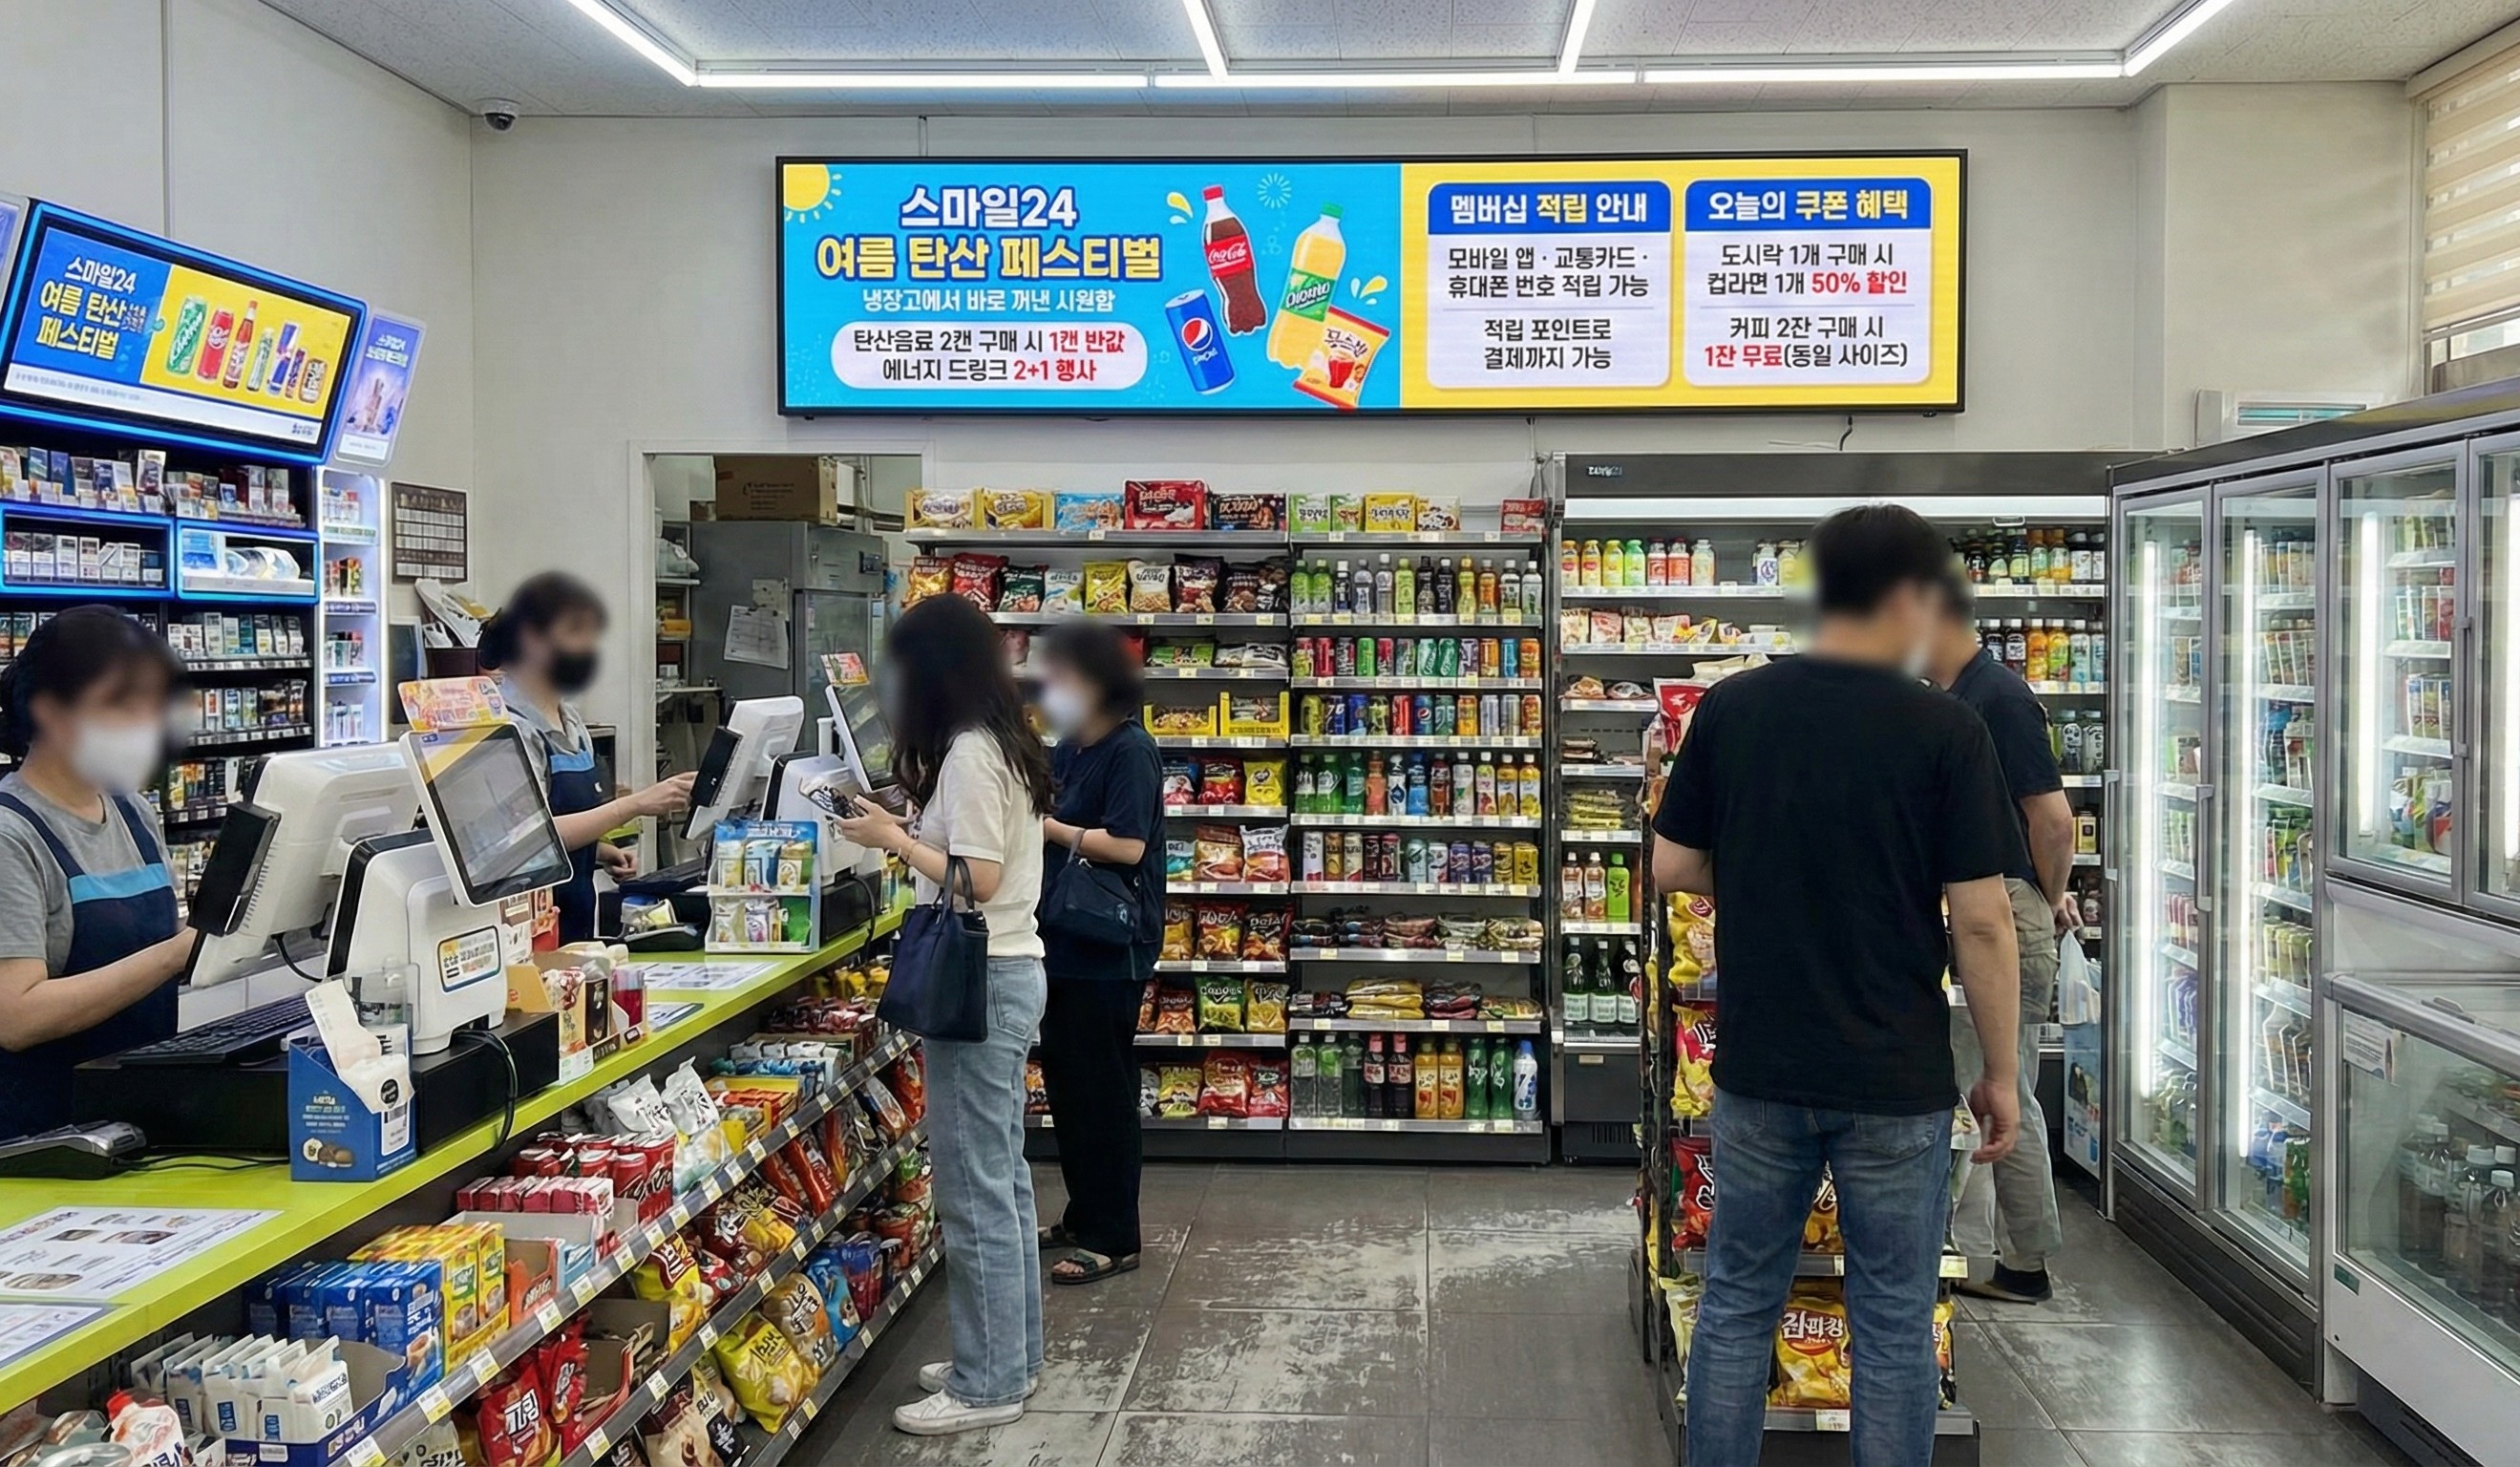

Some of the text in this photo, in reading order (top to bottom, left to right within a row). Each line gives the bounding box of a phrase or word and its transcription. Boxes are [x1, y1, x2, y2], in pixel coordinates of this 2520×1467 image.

[900, 187, 1076, 229] 스마일24
[1451, 192, 1648, 223] 멤버십 적립 안내
[1707, 189, 1908, 222] 오늘의 쿠폰 혜택
[816, 237, 1161, 280] 여름 탄산 페스티벌
[1448, 245, 1636, 270] 모바일 앱 교통카드
[1721, 243, 1894, 267] 도시락 1개 구매 시
[64, 256, 137, 294] 스마일24
[1448, 274, 1649, 298] 휴대폰 번호 적립 가능
[1707, 271, 1908, 296] 컵라면 1개 50% 할인
[41, 280, 83, 317] 여름
[85, 291, 127, 328] 탄산
[862, 288, 1115, 313] 냉장고에서 바로 꺼낸 시원함
[35, 315, 119, 360] 페스티벌
[1484, 318, 1612, 342] 적립 포인트로
[1729, 315, 1883, 339] 커피 2잔 구매 시
[854, 329, 1125, 352] 탄산음료 2캔 구매 시 1캔 반값
[1484, 346, 1612, 370] 결제까지 가능
[1705, 345, 1737, 369] 1잔
[1839, 343, 1908, 368] 사이즈)
[881, 358, 1097, 382] 에너지 드링크 2+1 행사
